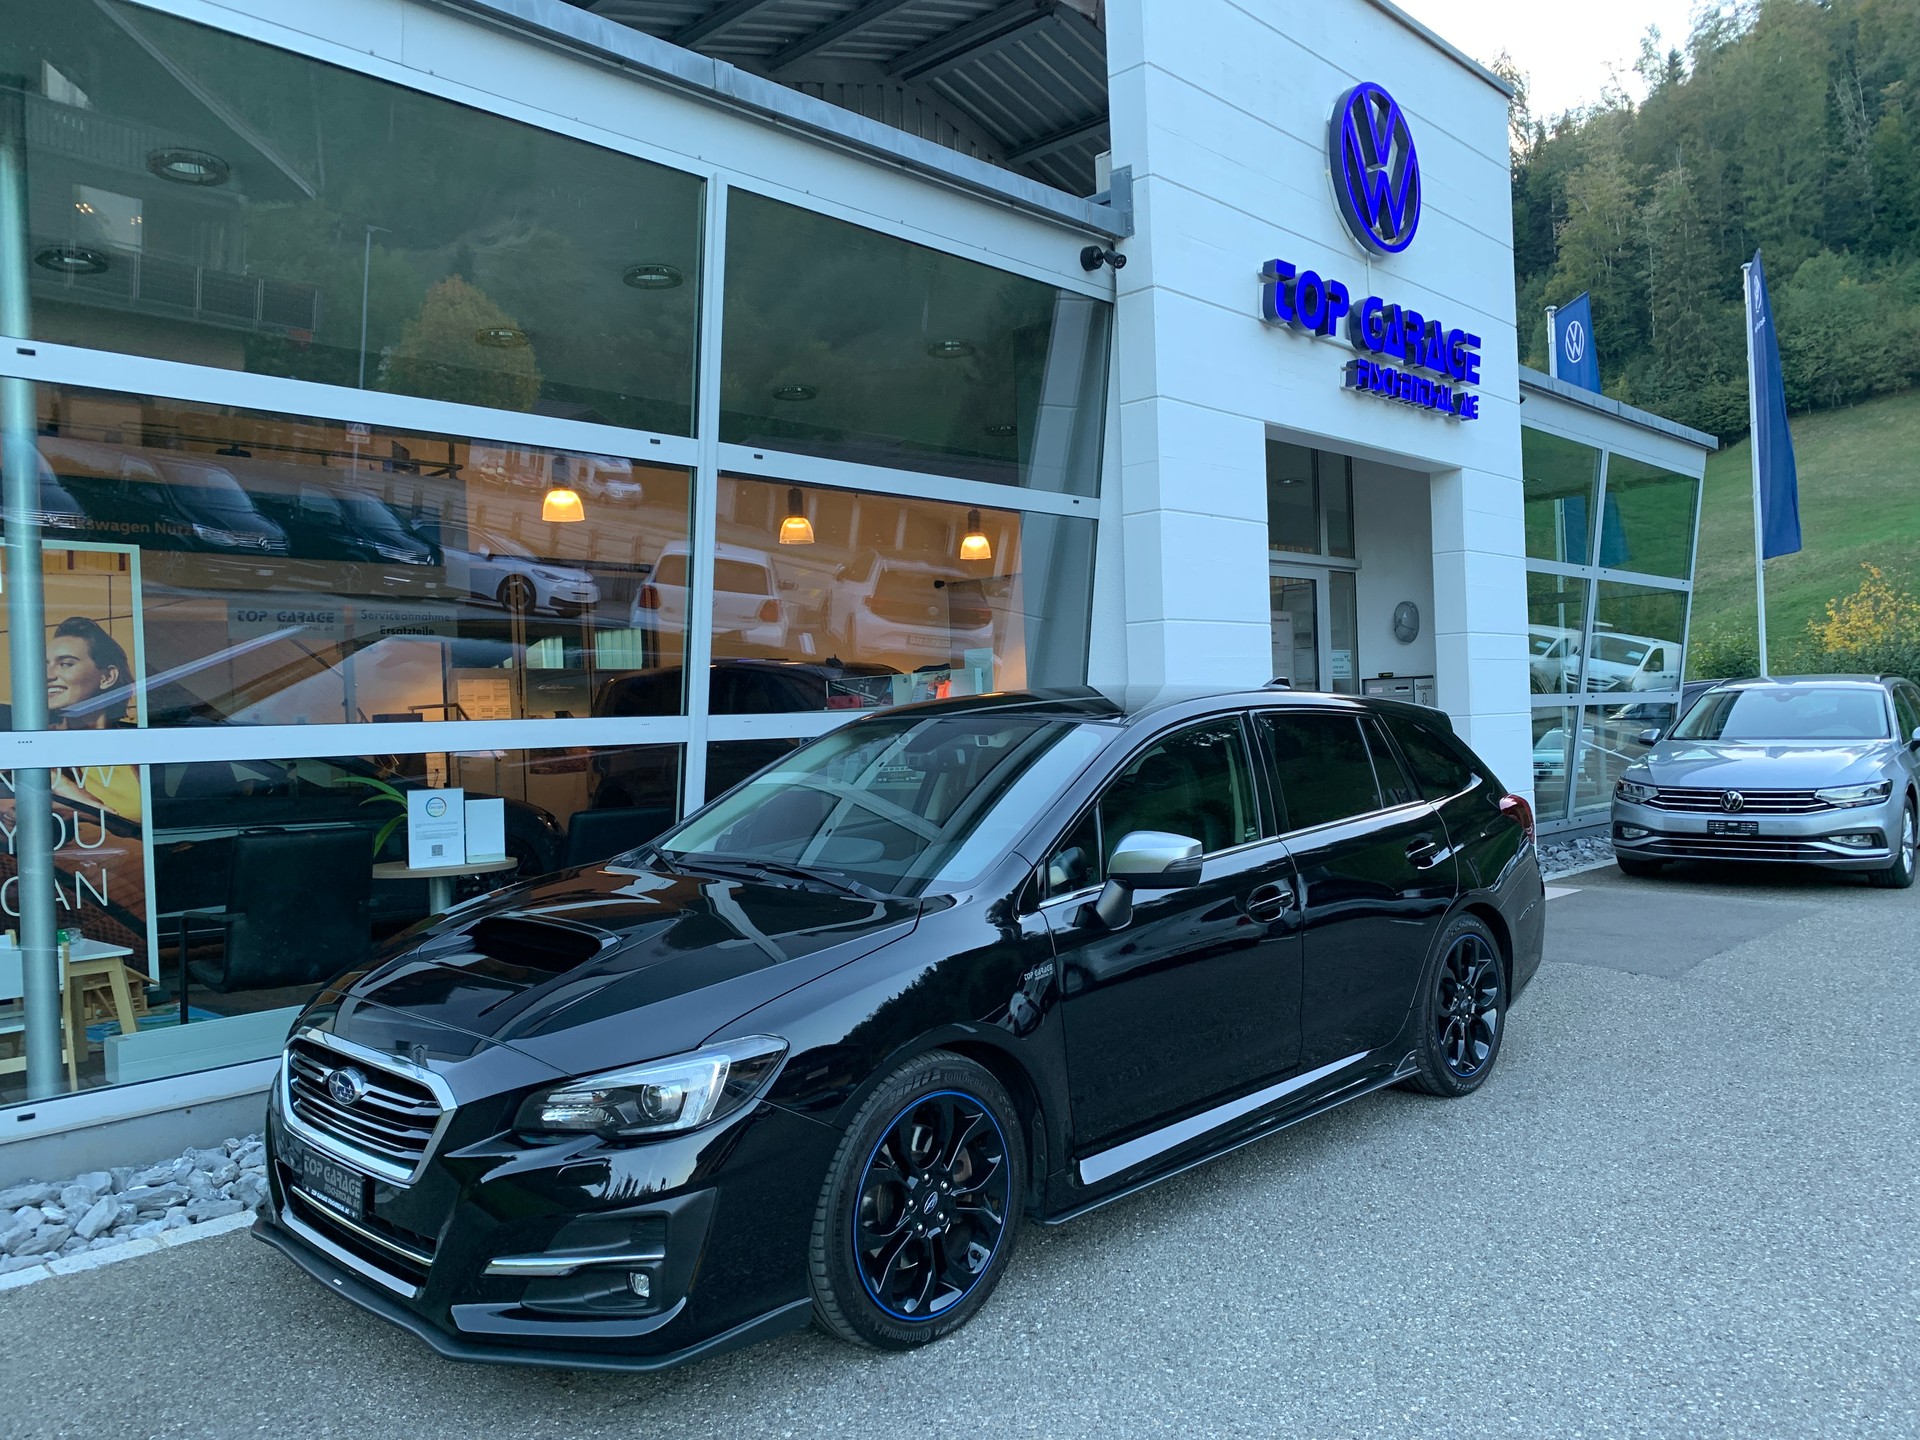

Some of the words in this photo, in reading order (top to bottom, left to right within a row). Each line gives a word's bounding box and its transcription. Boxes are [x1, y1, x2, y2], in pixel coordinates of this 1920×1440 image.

[1263, 259, 1349, 337] TOP
[1353, 296, 1481, 385] GARAGE
[1457, 392, 1479, 420] AG
[237, 610, 268, 623] TOP
[277, 610, 335, 624] GARAGE
[361, 609, 451, 623] Serviceannahme
[380, 625, 435, 636] Ersatzteile
[304, 1155, 323, 1178] TOP
[324, 1165, 361, 1199] GARAGE
[879, 1324, 932, 1344] Continental
